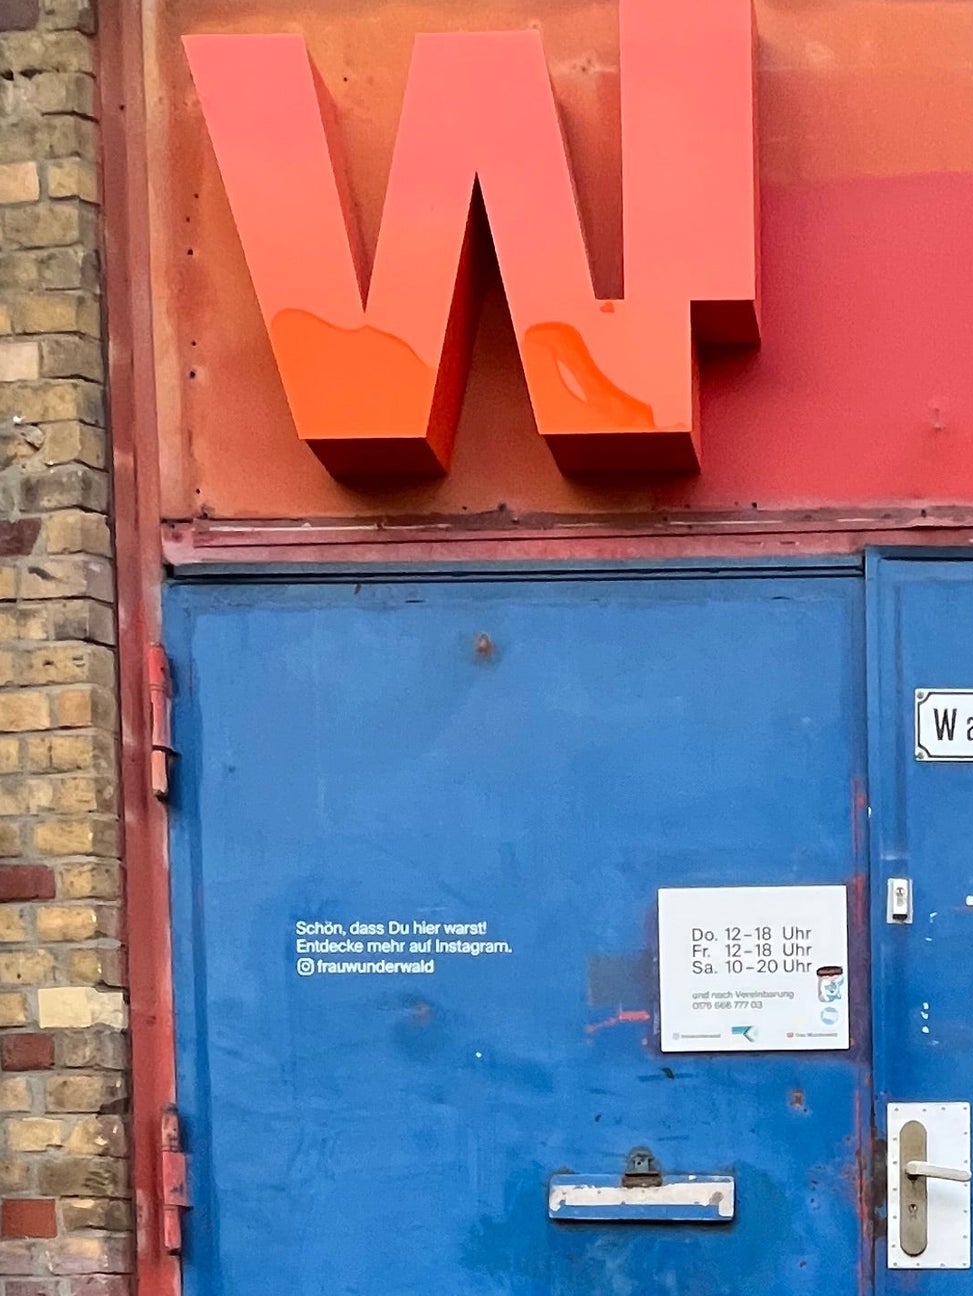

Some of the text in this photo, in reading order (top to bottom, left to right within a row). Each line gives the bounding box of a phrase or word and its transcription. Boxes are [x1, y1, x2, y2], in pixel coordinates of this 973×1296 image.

[295, 920, 488, 936] Schön, dass Du hier warst!
[692, 928, 718, 942] Do.
[782, 926, 813, 941] Uhr
[295, 939, 513, 956] Entdecke mehr auf Instagram.
[692, 944, 711, 958] Fr.
[782, 942, 813, 957] Uhr
[316, 959, 435, 974] frauwunderwald
[692, 960, 718, 974] Sa.
[782, 958, 813, 973] Uhr
